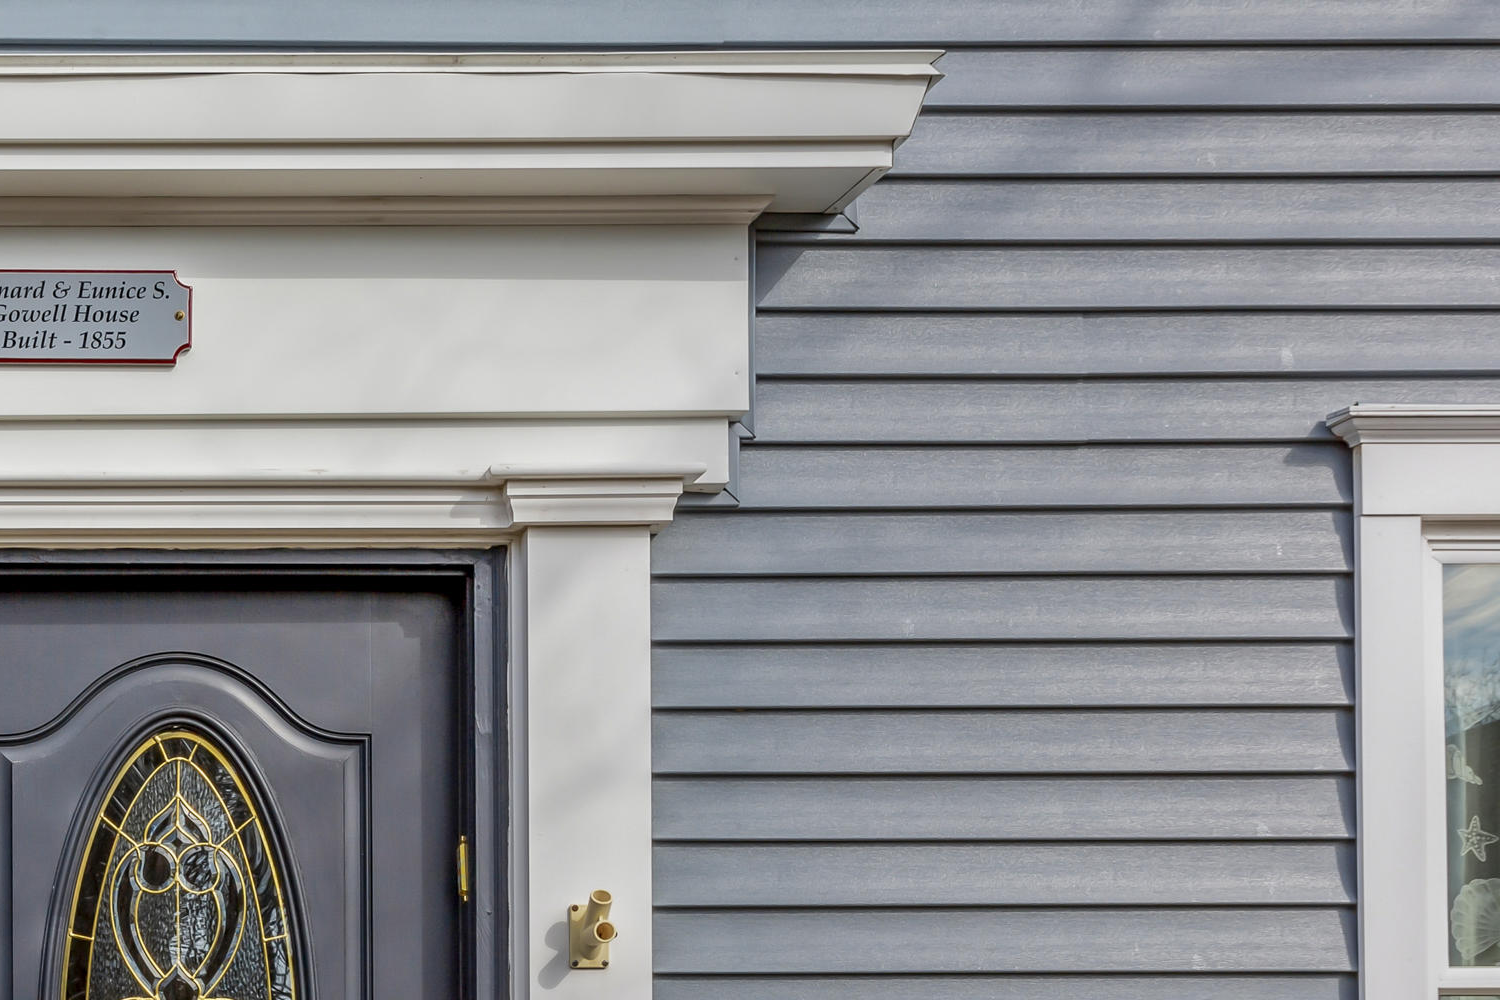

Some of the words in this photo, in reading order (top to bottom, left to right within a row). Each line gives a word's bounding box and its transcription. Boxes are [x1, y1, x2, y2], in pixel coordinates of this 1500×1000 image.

[52, 280, 72, 299] &
[77, 280, 147, 300] Eunice
[152, 280, 171, 300] S.
[72, 304, 140, 323] House
[1, 330, 58, 349] Built
[79, 331, 127, 350] 1855
